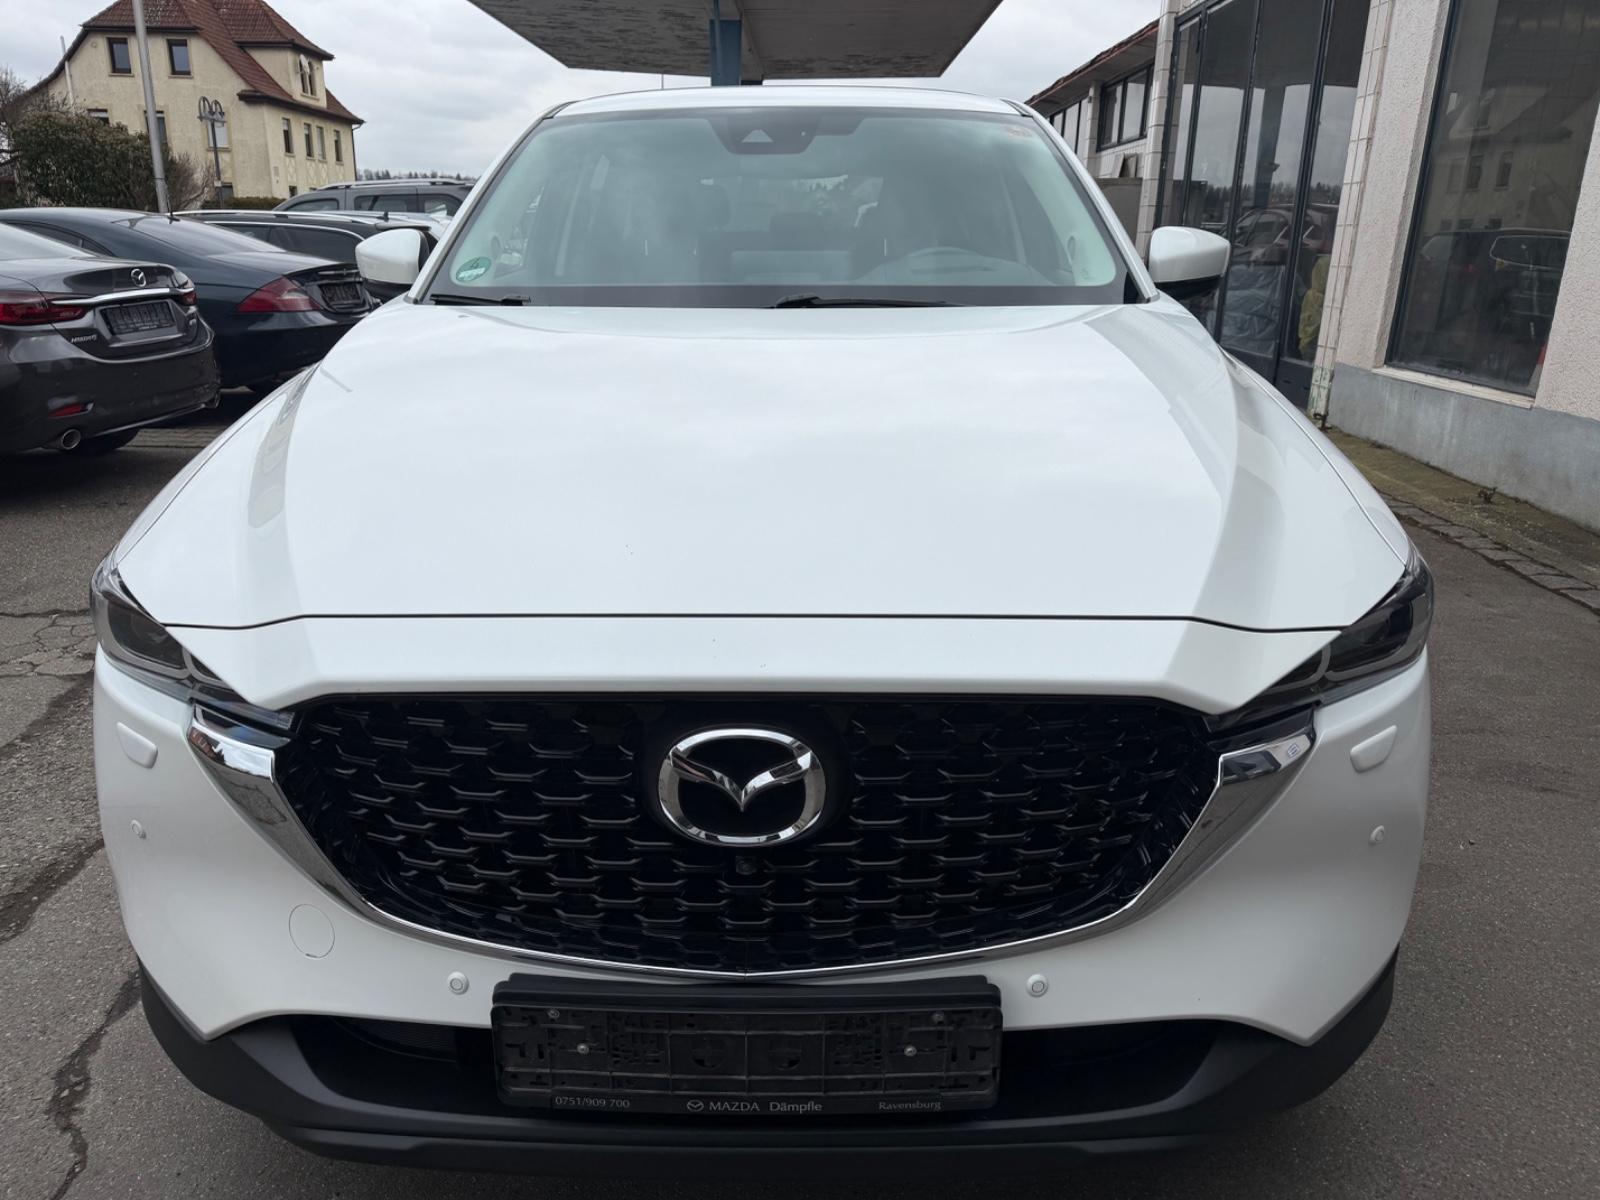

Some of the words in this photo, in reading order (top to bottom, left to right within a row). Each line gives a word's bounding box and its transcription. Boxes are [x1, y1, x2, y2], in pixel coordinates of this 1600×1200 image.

[555, 1096, 606, 1107] 0751/909
[609, 1099, 631, 1108] 700
[709, 1101, 760, 1111] MAZDA
[769, 1100, 822, 1114] Dämpfle
[879, 1100, 941, 1111] Ravensburg
